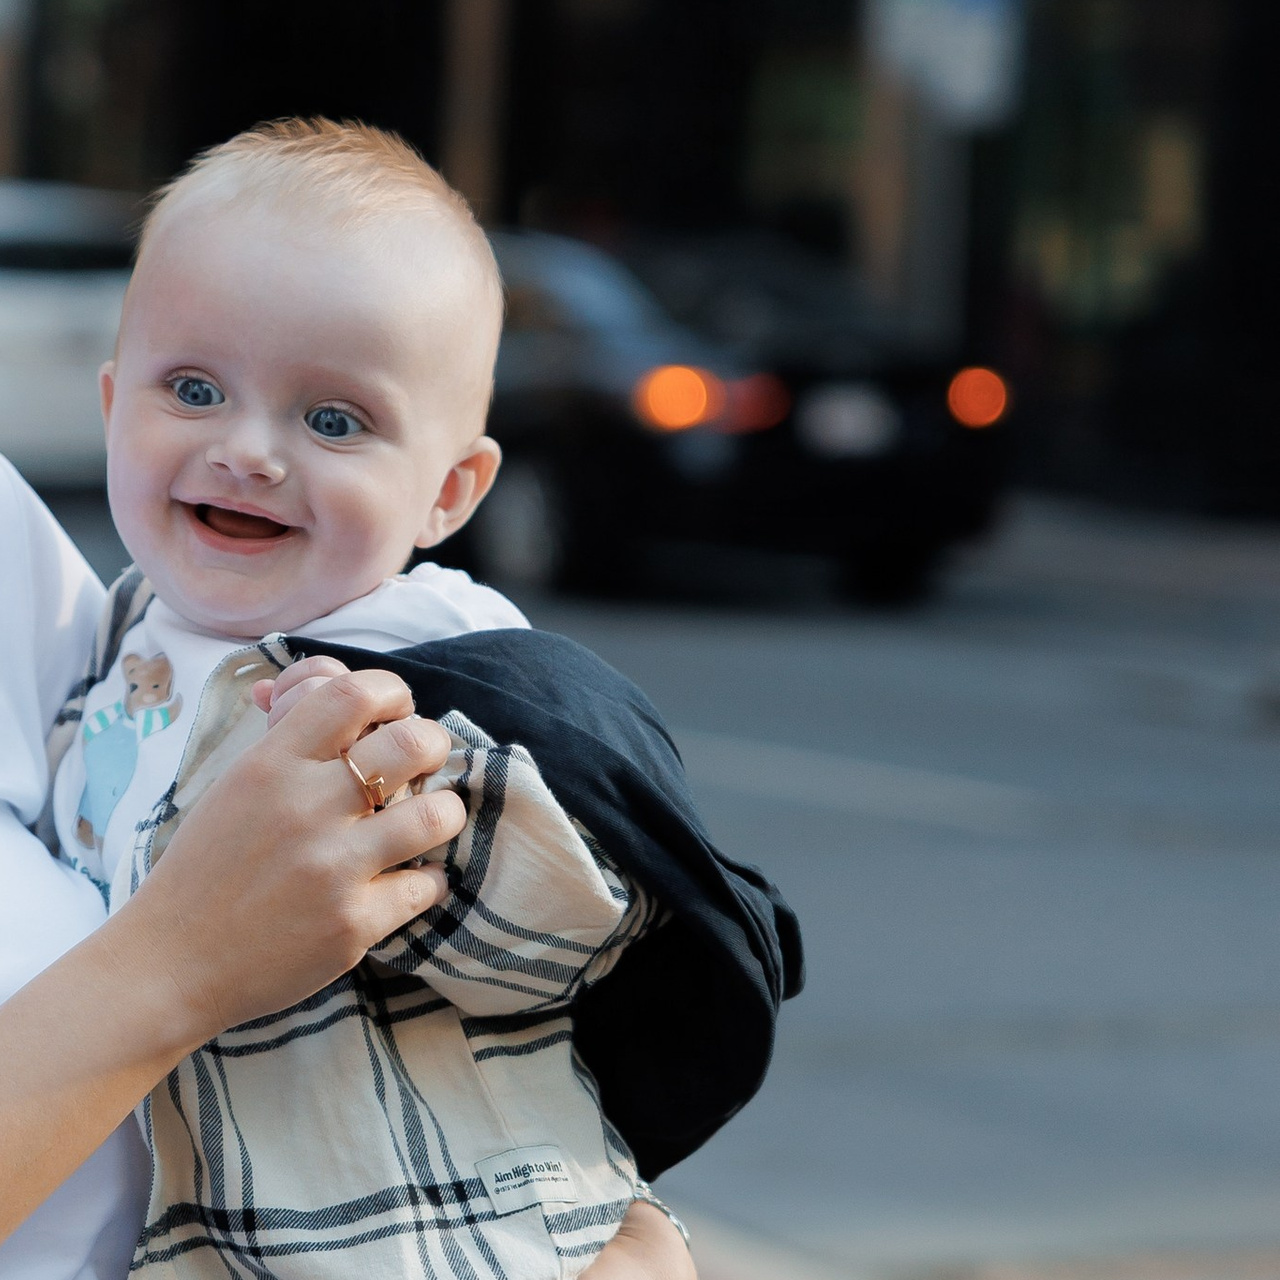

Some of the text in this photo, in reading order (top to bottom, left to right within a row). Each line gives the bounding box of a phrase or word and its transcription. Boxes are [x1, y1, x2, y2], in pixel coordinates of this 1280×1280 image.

[494, 1161, 563, 1184] Aim High to Win!
